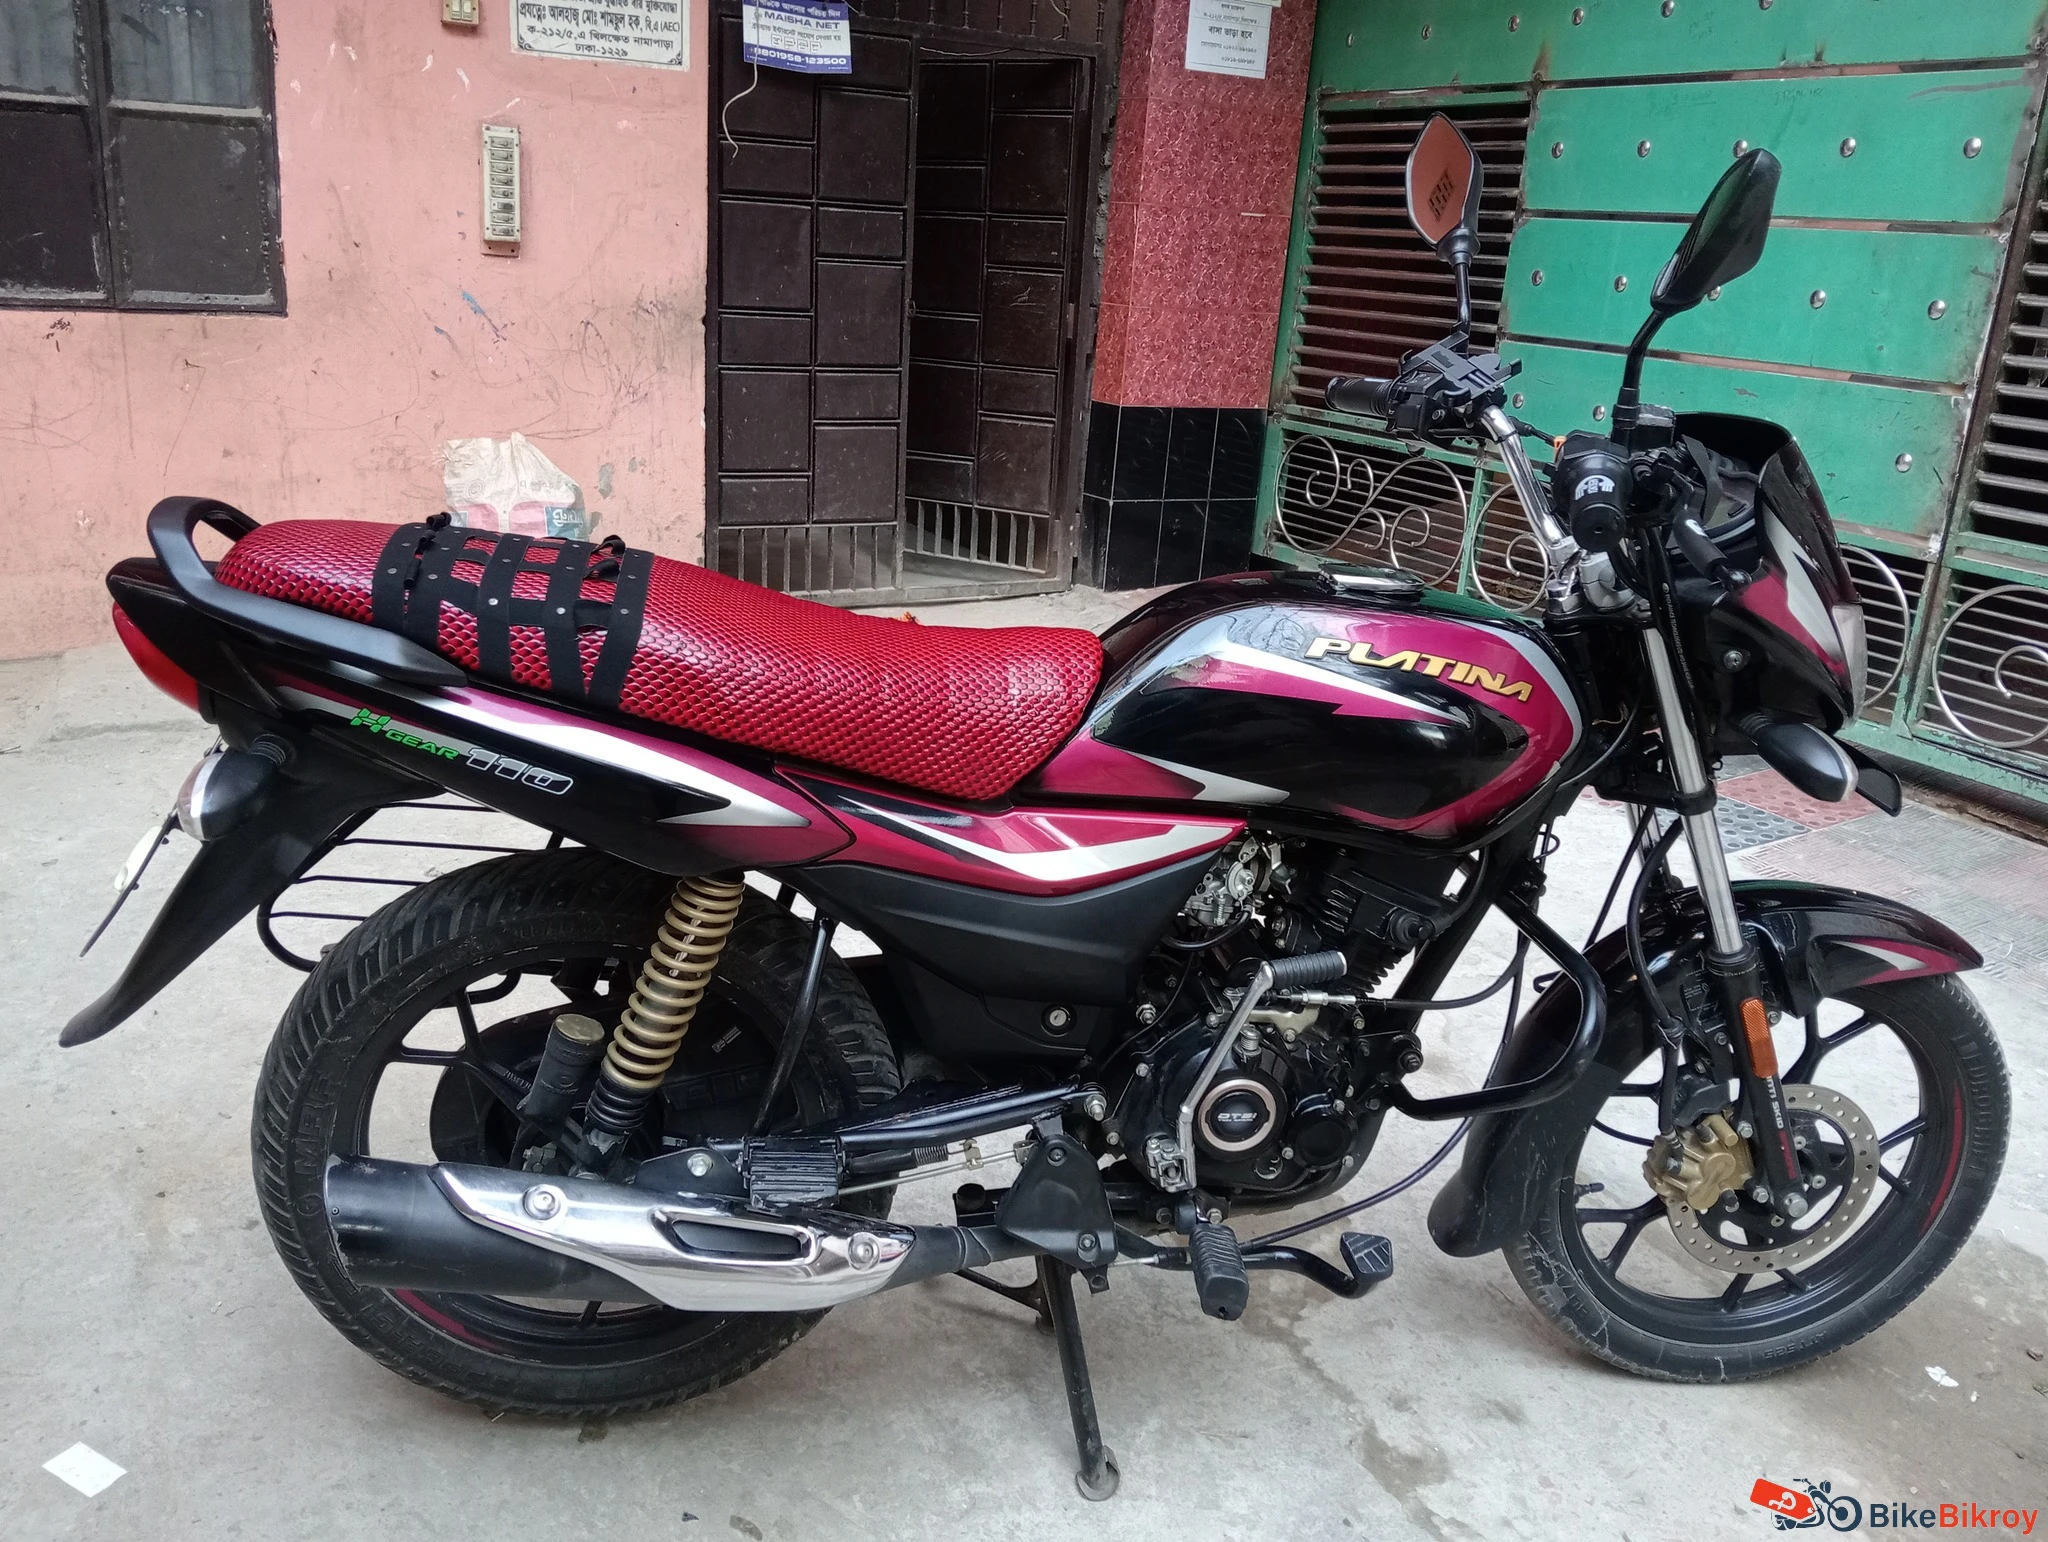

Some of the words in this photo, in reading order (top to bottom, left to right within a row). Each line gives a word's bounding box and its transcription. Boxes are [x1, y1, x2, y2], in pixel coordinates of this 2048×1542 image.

[581, 9, 598, 26] মোঃ
[660, 21, 681, 33] (AEC)
[764, 11, 812, 28] MAISHA
[816, 21, 841, 30] NET
[575, 43, 629, 57] ঢাকা-১২২৯
[1303, 636, 1533, 702] PLATINA
[385, 729, 460, 760] GEAR
[466, 747, 574, 796] 110
[1772, 1101, 1784, 1129] SKID
